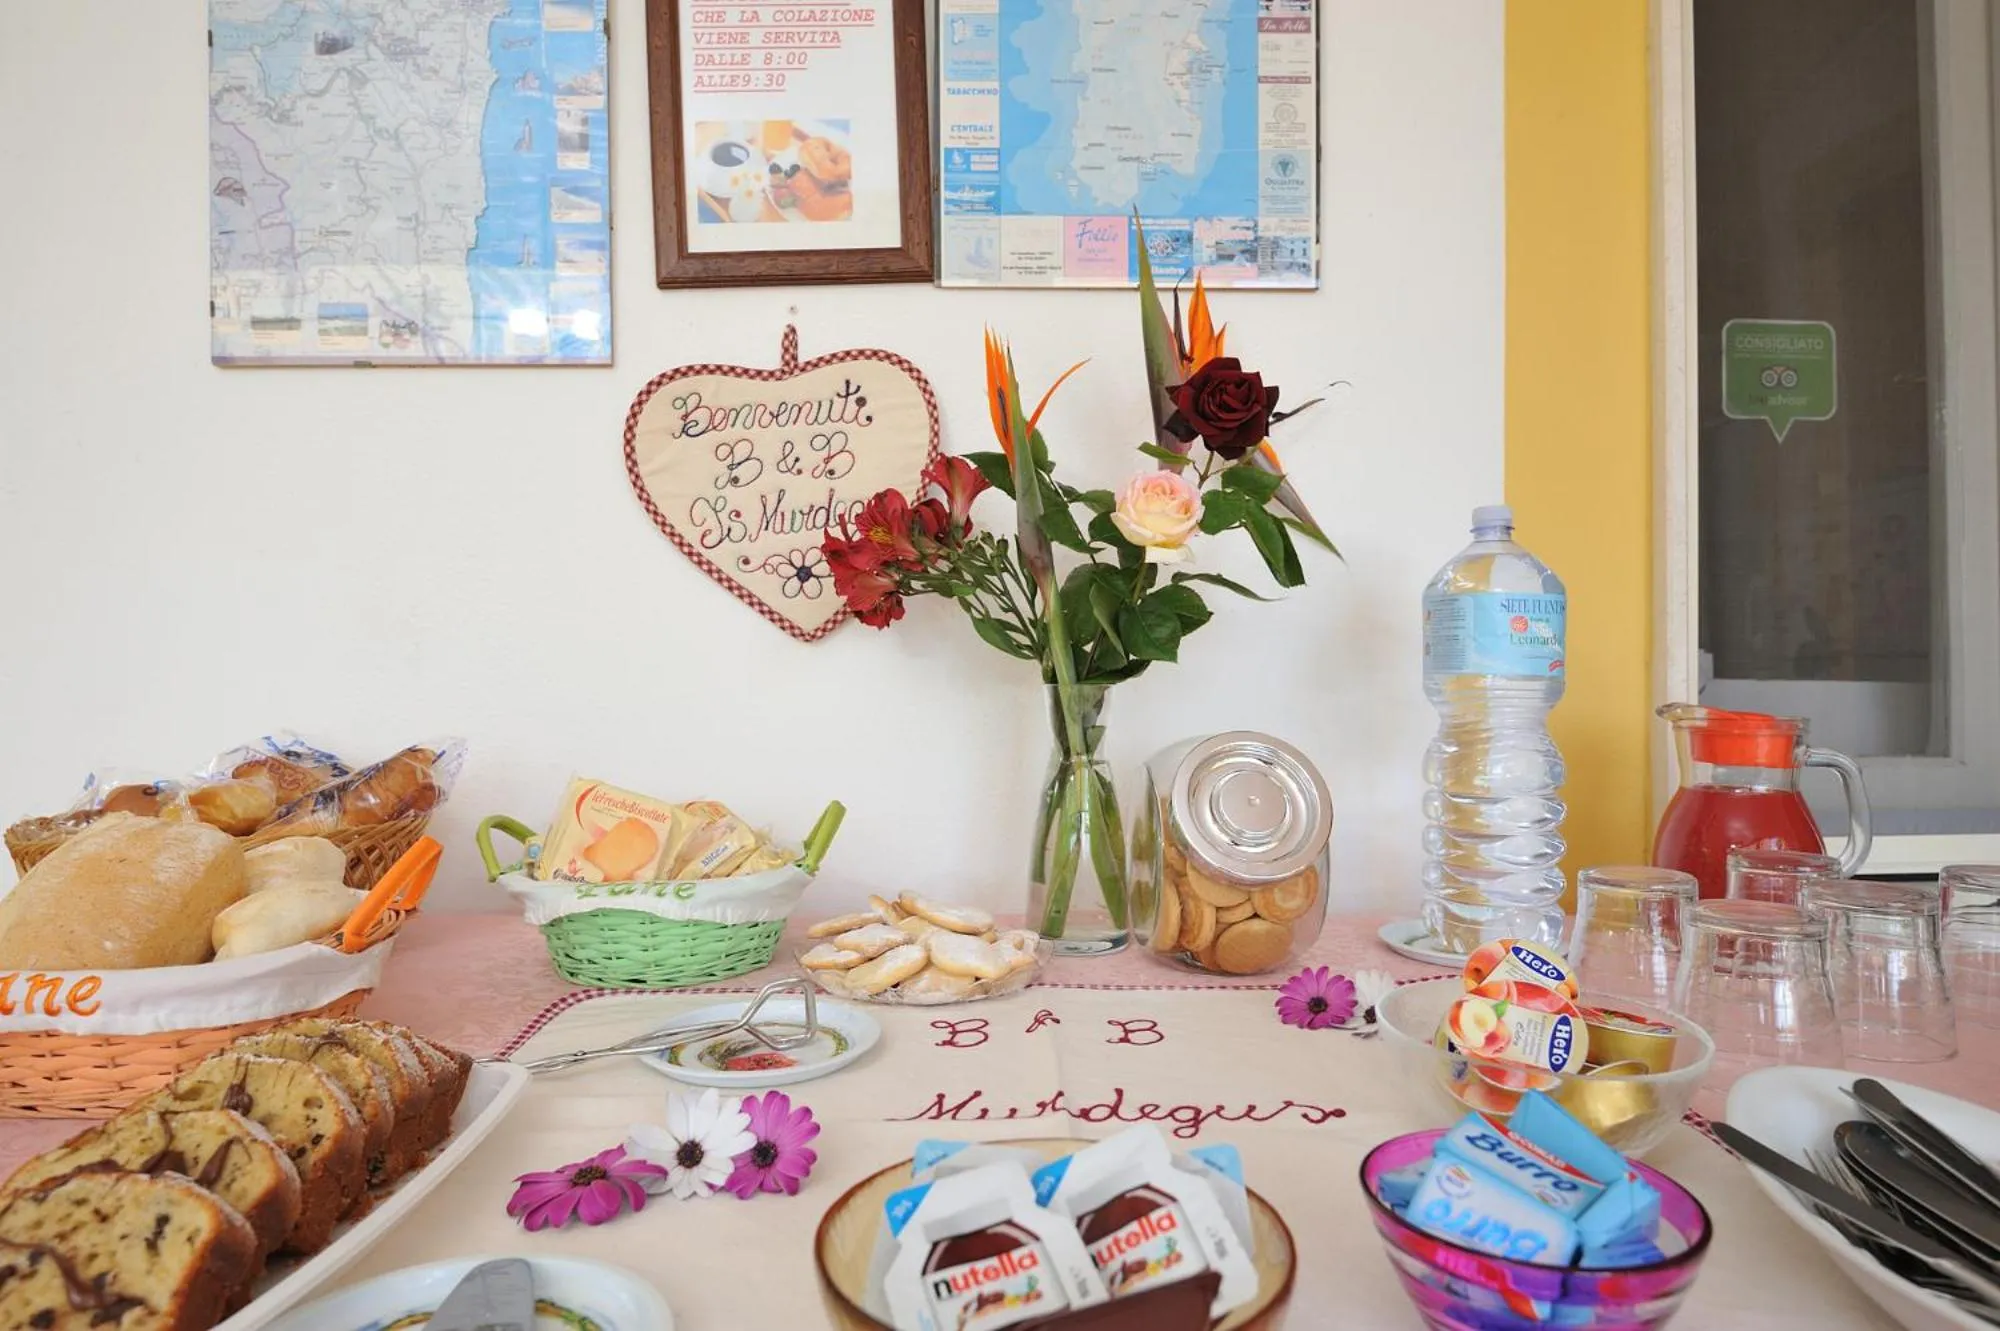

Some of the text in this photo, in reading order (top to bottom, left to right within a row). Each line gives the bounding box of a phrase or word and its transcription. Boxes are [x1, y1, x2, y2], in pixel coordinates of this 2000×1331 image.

[692, 9, 875, 23] CHE LA COLAZIONE
[693, 31, 841, 45] VIENE SERVITA
[694, 52, 808, 66] DALLE 8:00
[693, 73, 786, 88] ALLE9:30
[1735, 335, 1825, 351] CONSIGLIATO
[714, 431, 856, 490] B & B
[1500, 598, 1530, 613] SIETE
[1518, 949, 1557, 978] Hero
[930, 1018, 989, 1048] B
[1106, 1019, 1164, 1046] B
[1551, 1024, 1571, 1065] Hero
[1465, 1133, 1579, 1192] Burro
[933, 1250, 1039, 1300] nutella
